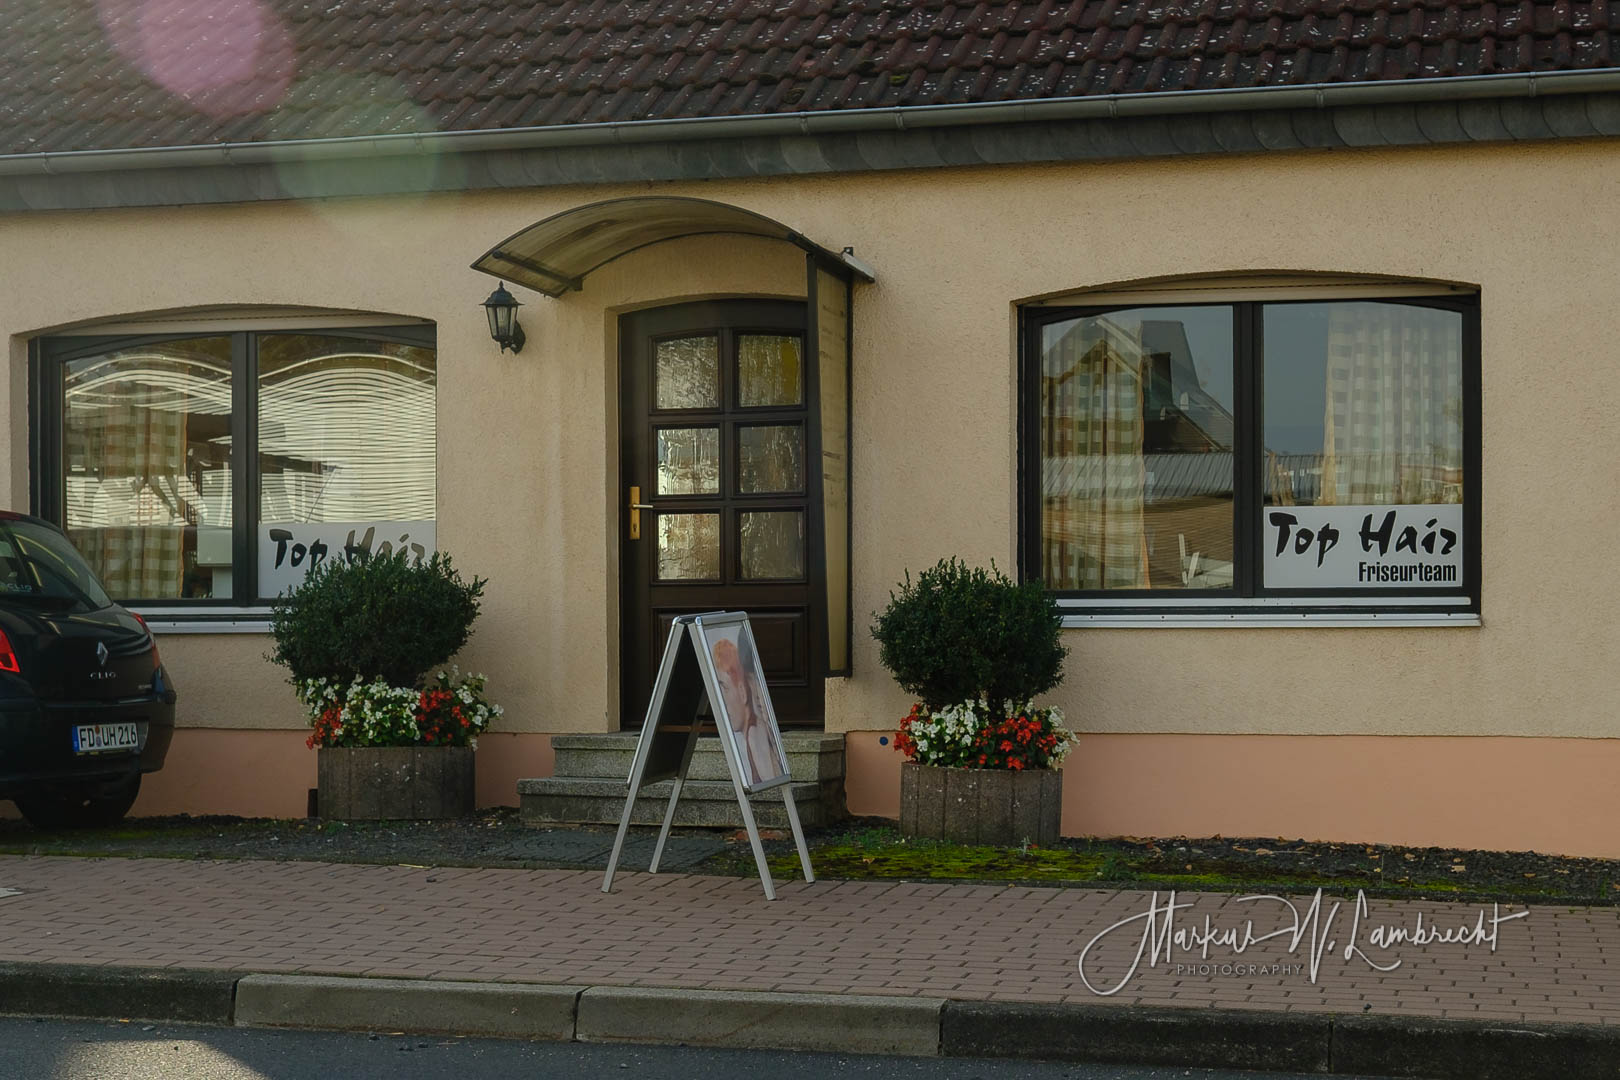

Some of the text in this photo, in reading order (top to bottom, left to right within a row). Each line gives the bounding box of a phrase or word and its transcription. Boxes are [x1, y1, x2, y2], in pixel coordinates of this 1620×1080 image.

[269, 528, 328, 573] Top
[1269, 510, 1457, 568] Top Hair
[1358, 561, 1457, 582] Friseurteam
[80, 725, 137, 748] FD UH 216
